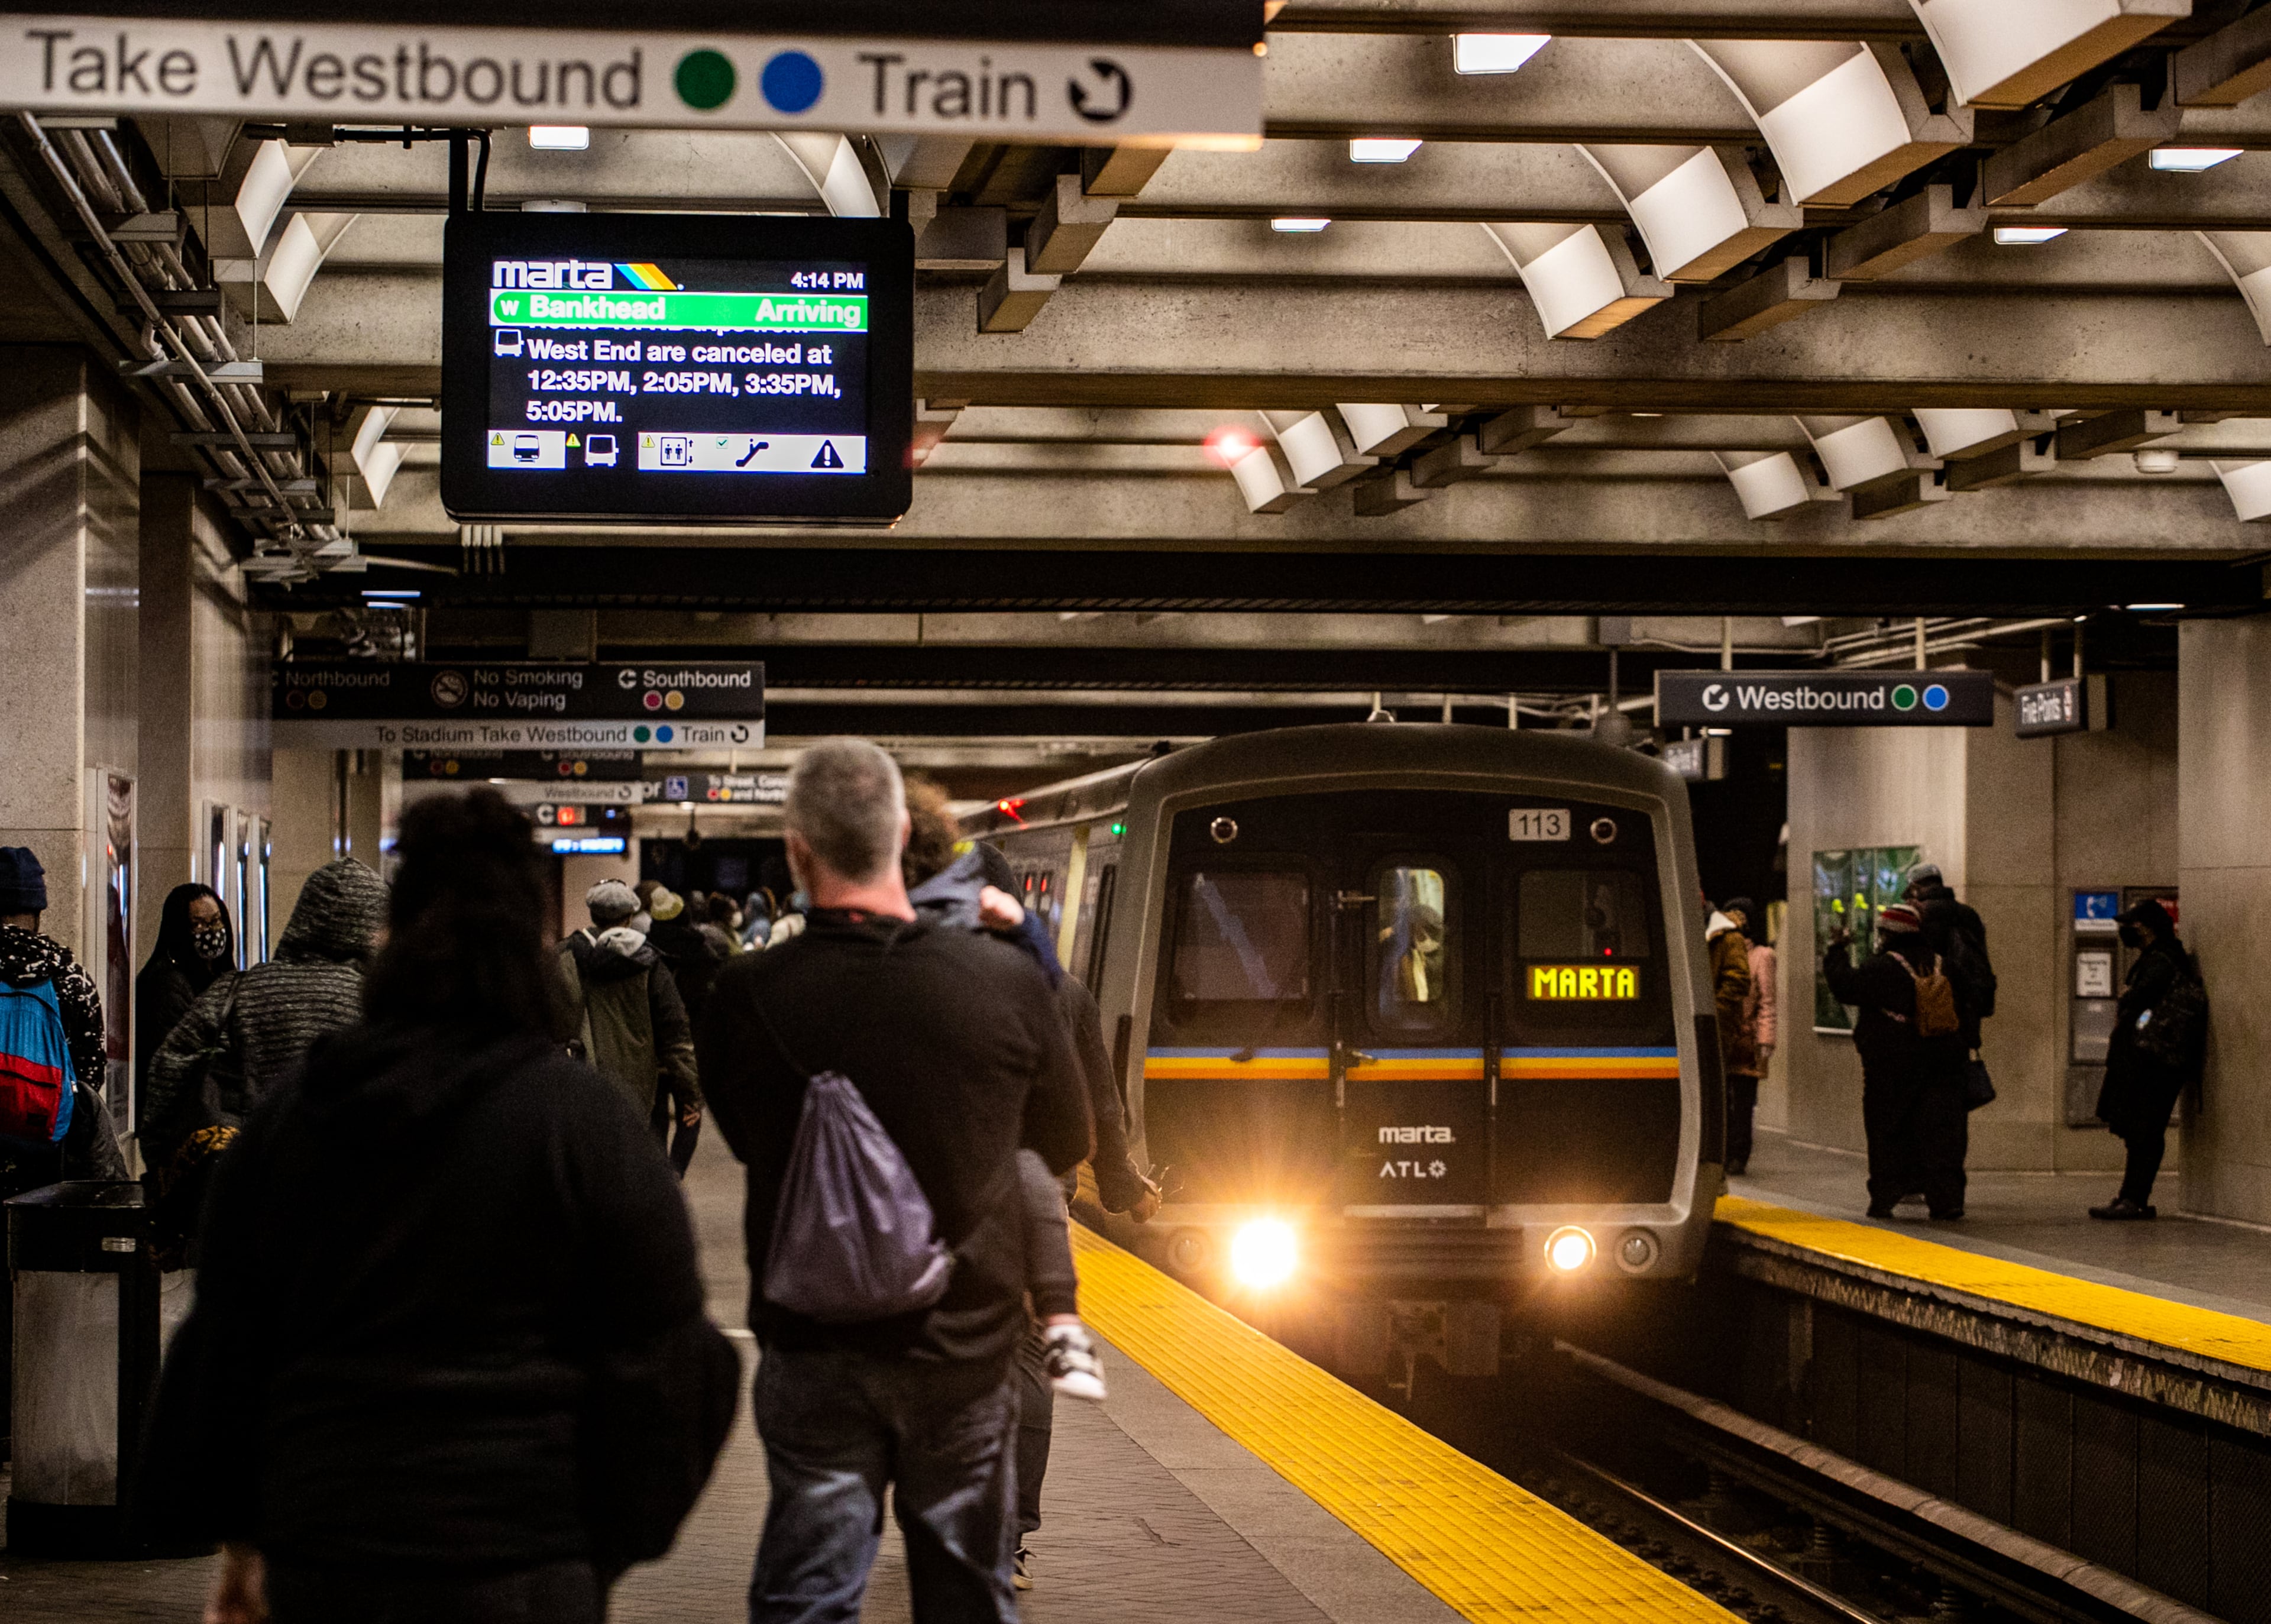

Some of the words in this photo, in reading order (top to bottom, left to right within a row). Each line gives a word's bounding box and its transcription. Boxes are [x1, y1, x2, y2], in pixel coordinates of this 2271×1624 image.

[25, 30, 198, 97] Take
[227, 35, 642, 110] Westbound
[856, 52, 1038, 120] Train
[493, 259, 613, 289] marta
[791, 271, 830, 289] 4:14
[833, 273, 864, 289] PM
[530, 295, 666, 320] Bankhead
[755, 298, 860, 328] Arriving
[527, 339, 588, 360] West
[594, 339, 642, 361] End
[646, 345, 687, 361] are
[692, 342, 801, 364] canceled
[807, 345, 832, 364] at
[528, 369, 638, 396] 12:35PM,
[642, 371, 739, 397] 2:05PM,
[745, 374, 841, 399] 3:35PM,
[526, 400, 623, 423] 5:05PM.
[286, 671, 390, 687] Northbound
[474, 670, 499, 685] No
[505, 669, 584, 690] Smoking
[643, 670, 752, 687] Southbound
[474, 692, 499, 707] No
[505, 691, 567, 711] Vaping
[1738, 687, 1885, 710] Westbound
[377, 726, 396, 742] To
[402, 726, 474, 742] Stadium
[480, 726, 521, 742] Take
[526, 726, 627, 743] Westbound
[681, 726, 724, 742] Train
[1517, 813, 1561, 836] 113
[1533, 966, 1635, 998] MARTA
[1379, 1125, 1451, 1143] marta
